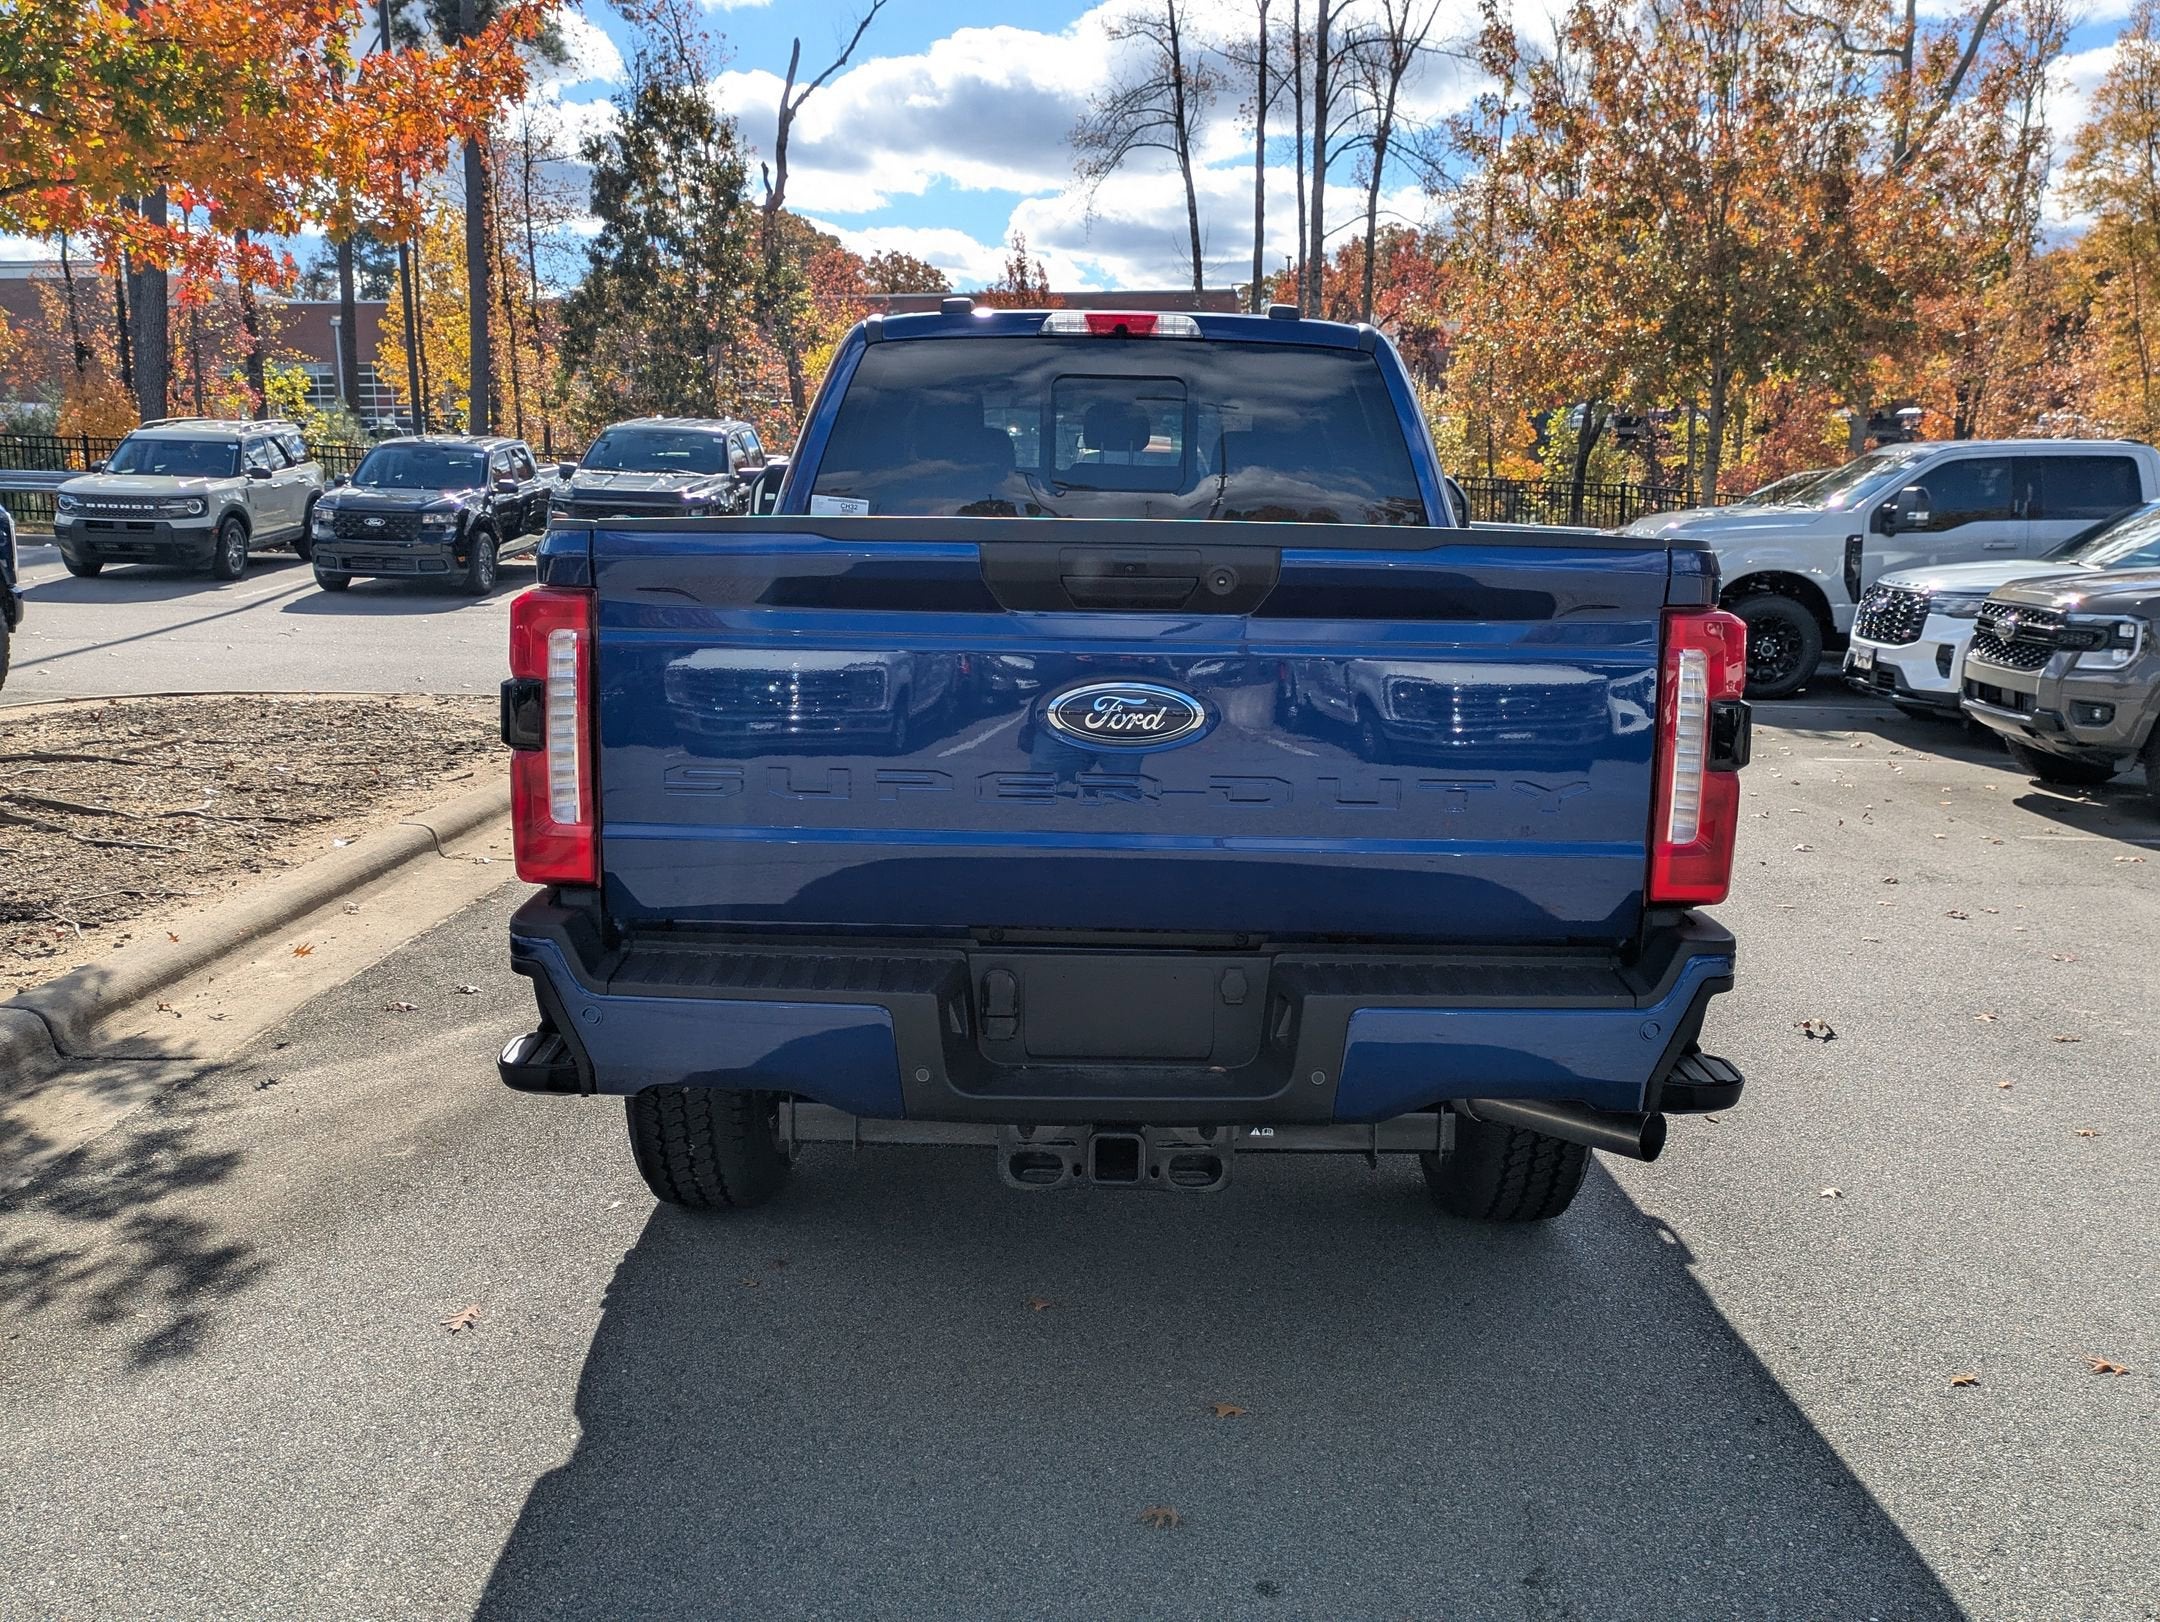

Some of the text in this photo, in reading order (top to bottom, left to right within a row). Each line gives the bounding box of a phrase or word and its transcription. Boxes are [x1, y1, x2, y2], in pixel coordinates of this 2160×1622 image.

[1085, 696, 1167, 730] Ford
[663, 763, 1593, 814] SUPER DUTY
